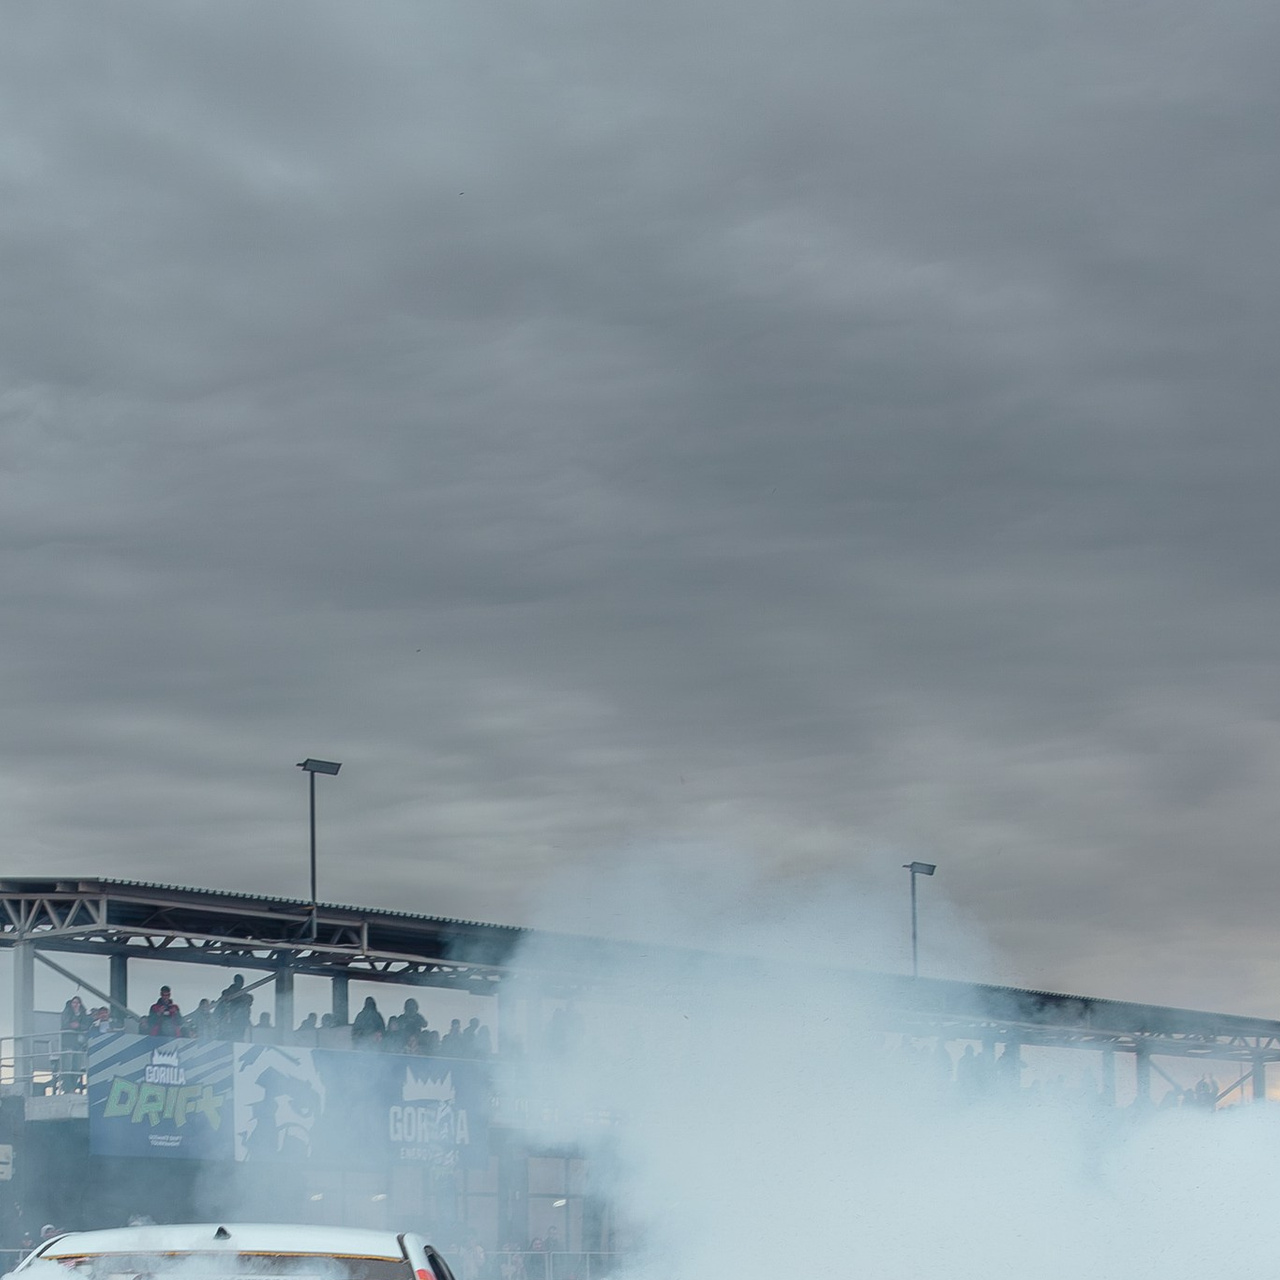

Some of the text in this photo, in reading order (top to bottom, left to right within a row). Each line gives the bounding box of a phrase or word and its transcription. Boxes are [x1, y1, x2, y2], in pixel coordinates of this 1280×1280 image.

[145, 1065, 187, 1086] GORILLA
[103, 1076, 225, 1132] DRIFT
[389, 1105, 470, 1145] GORA
